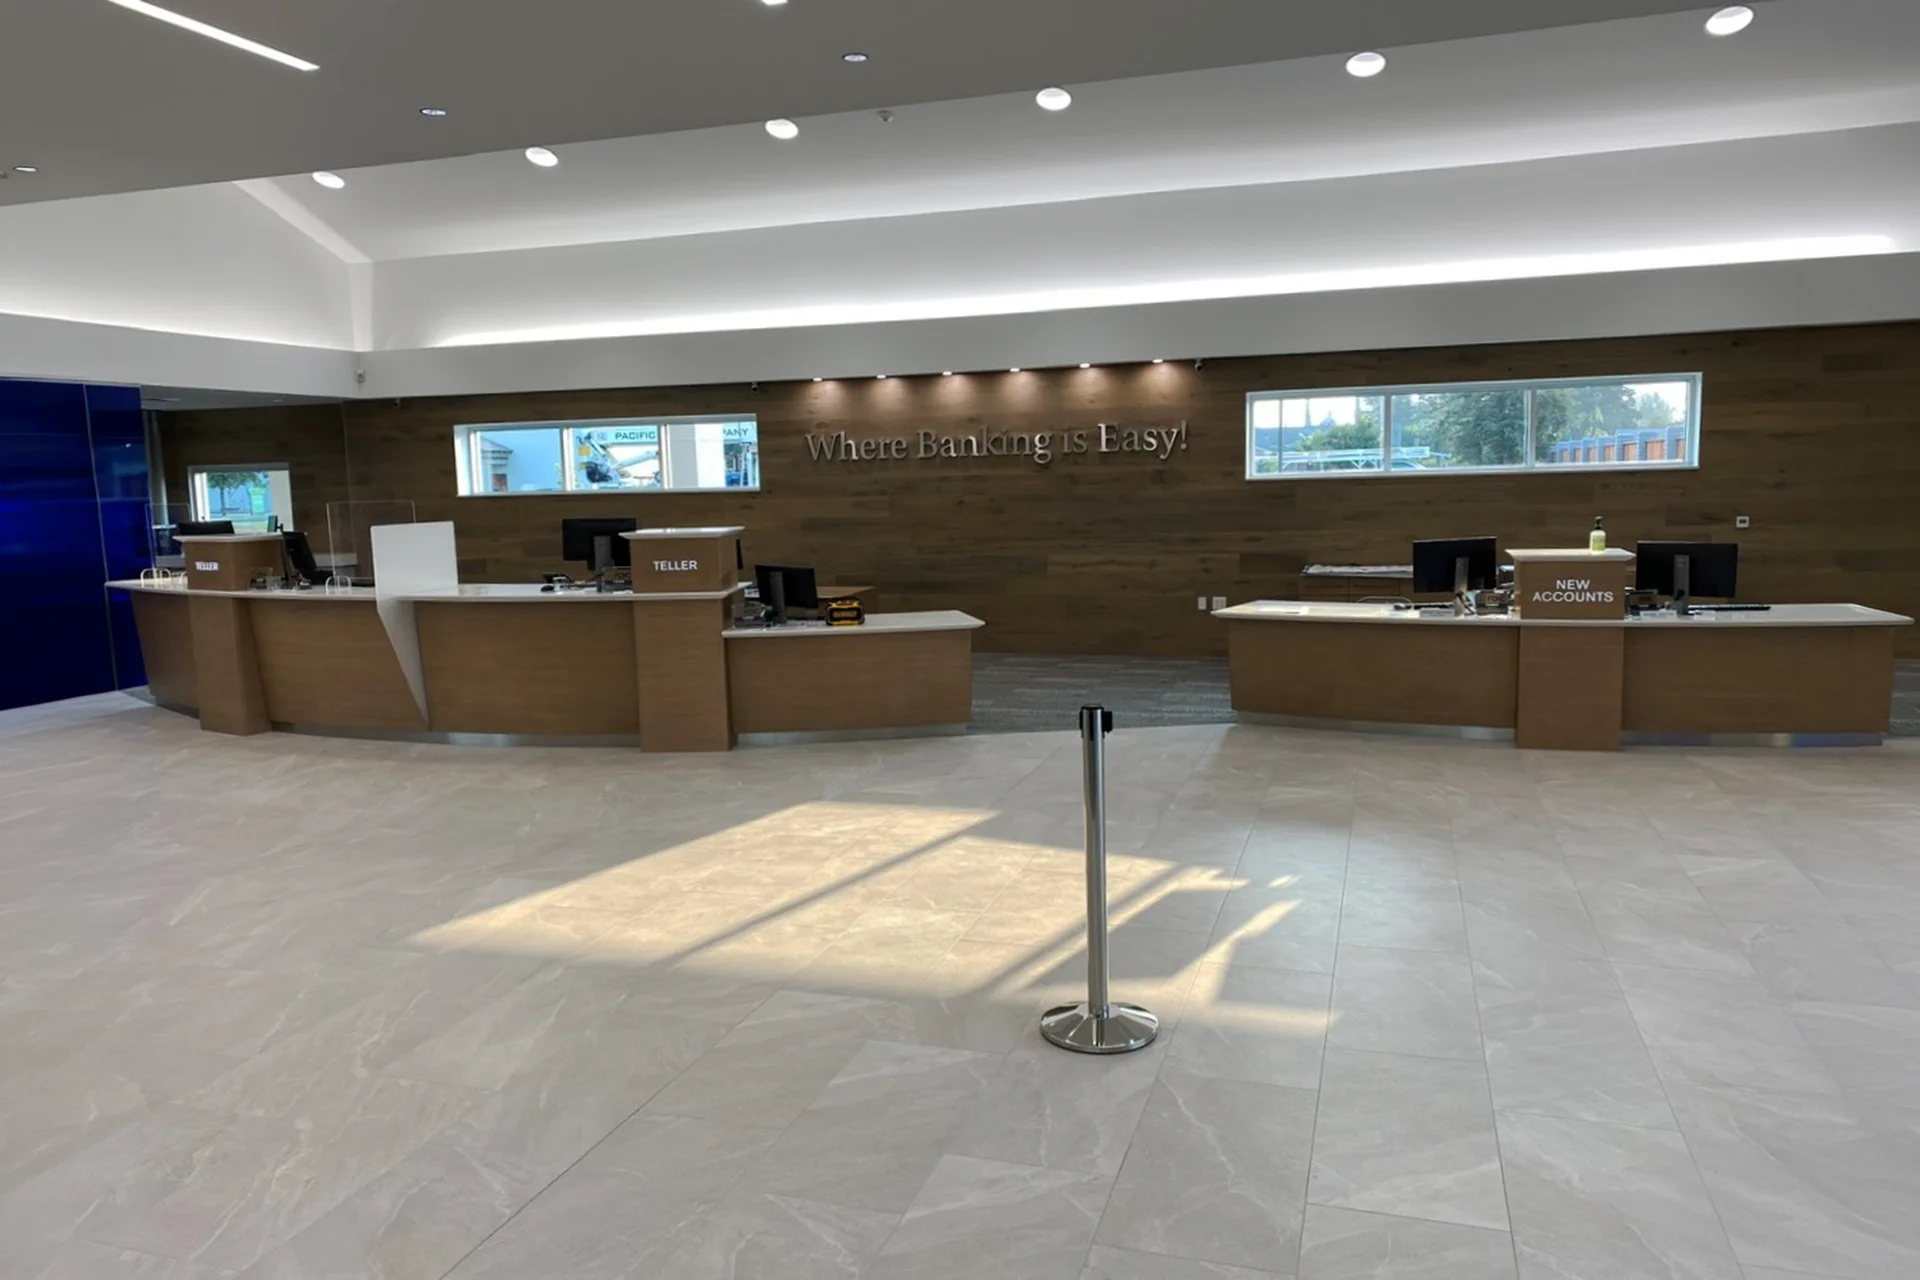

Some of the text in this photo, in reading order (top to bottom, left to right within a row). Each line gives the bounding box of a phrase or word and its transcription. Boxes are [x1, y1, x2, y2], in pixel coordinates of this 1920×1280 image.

[615, 431, 656, 440] PACIFIC
[804, 419, 1189, 464] Where Banking is Easy!
[195, 561, 219, 571] TELLER
[652, 560, 698, 571] TELLER
[1555, 579, 1591, 590] NEW
[1532, 591, 1614, 603] ACCOUNTS
